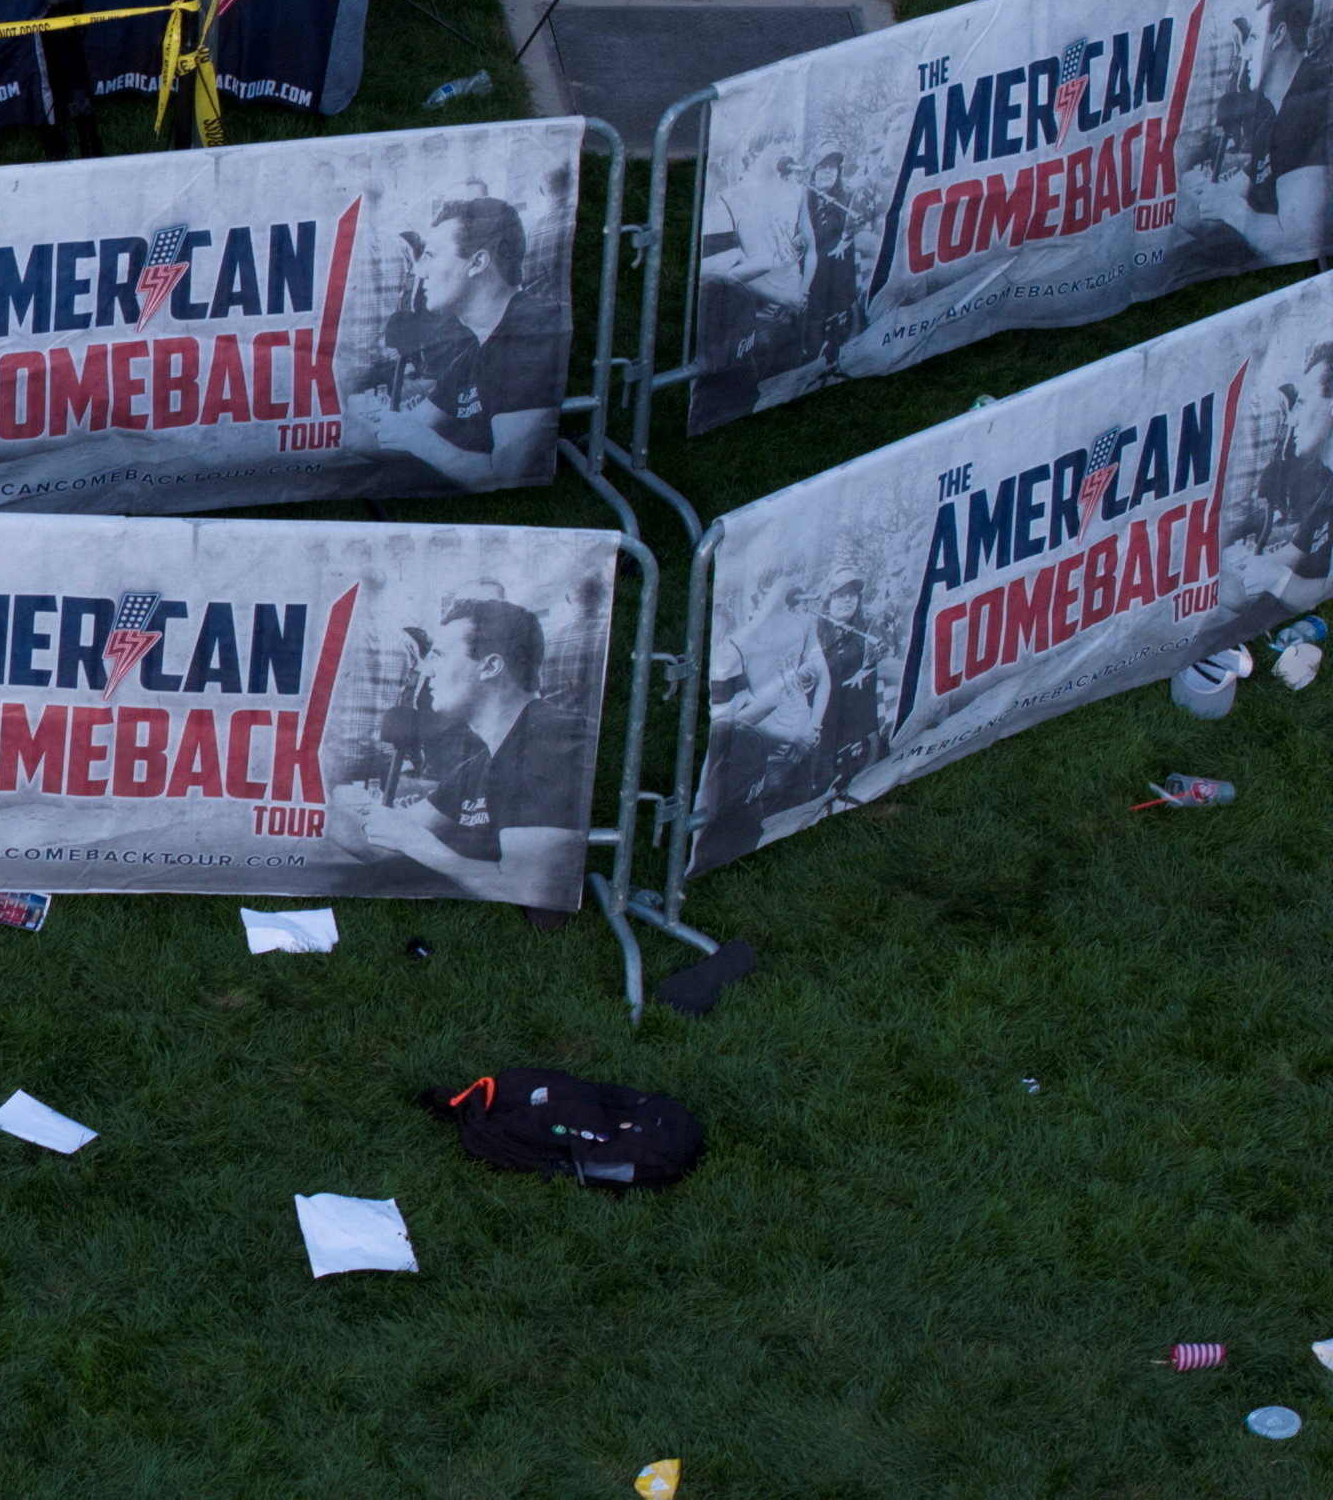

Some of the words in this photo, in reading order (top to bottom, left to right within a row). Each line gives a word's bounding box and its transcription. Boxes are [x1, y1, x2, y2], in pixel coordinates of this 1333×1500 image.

[918, 56, 950, 92] THE
[867, 18, 1174, 311] AMERICAN
[1135, 199, 1176, 233] OUR
[276, 420, 342, 452] TOUR
[938, 462, 973, 502] THE
[935, 358, 1250, 697] COMEBACK
[891, 392, 1215, 742] AMERICAN
[1172, 584, 1219, 623] TOUR
[253, 805, 325, 838] TOUR
